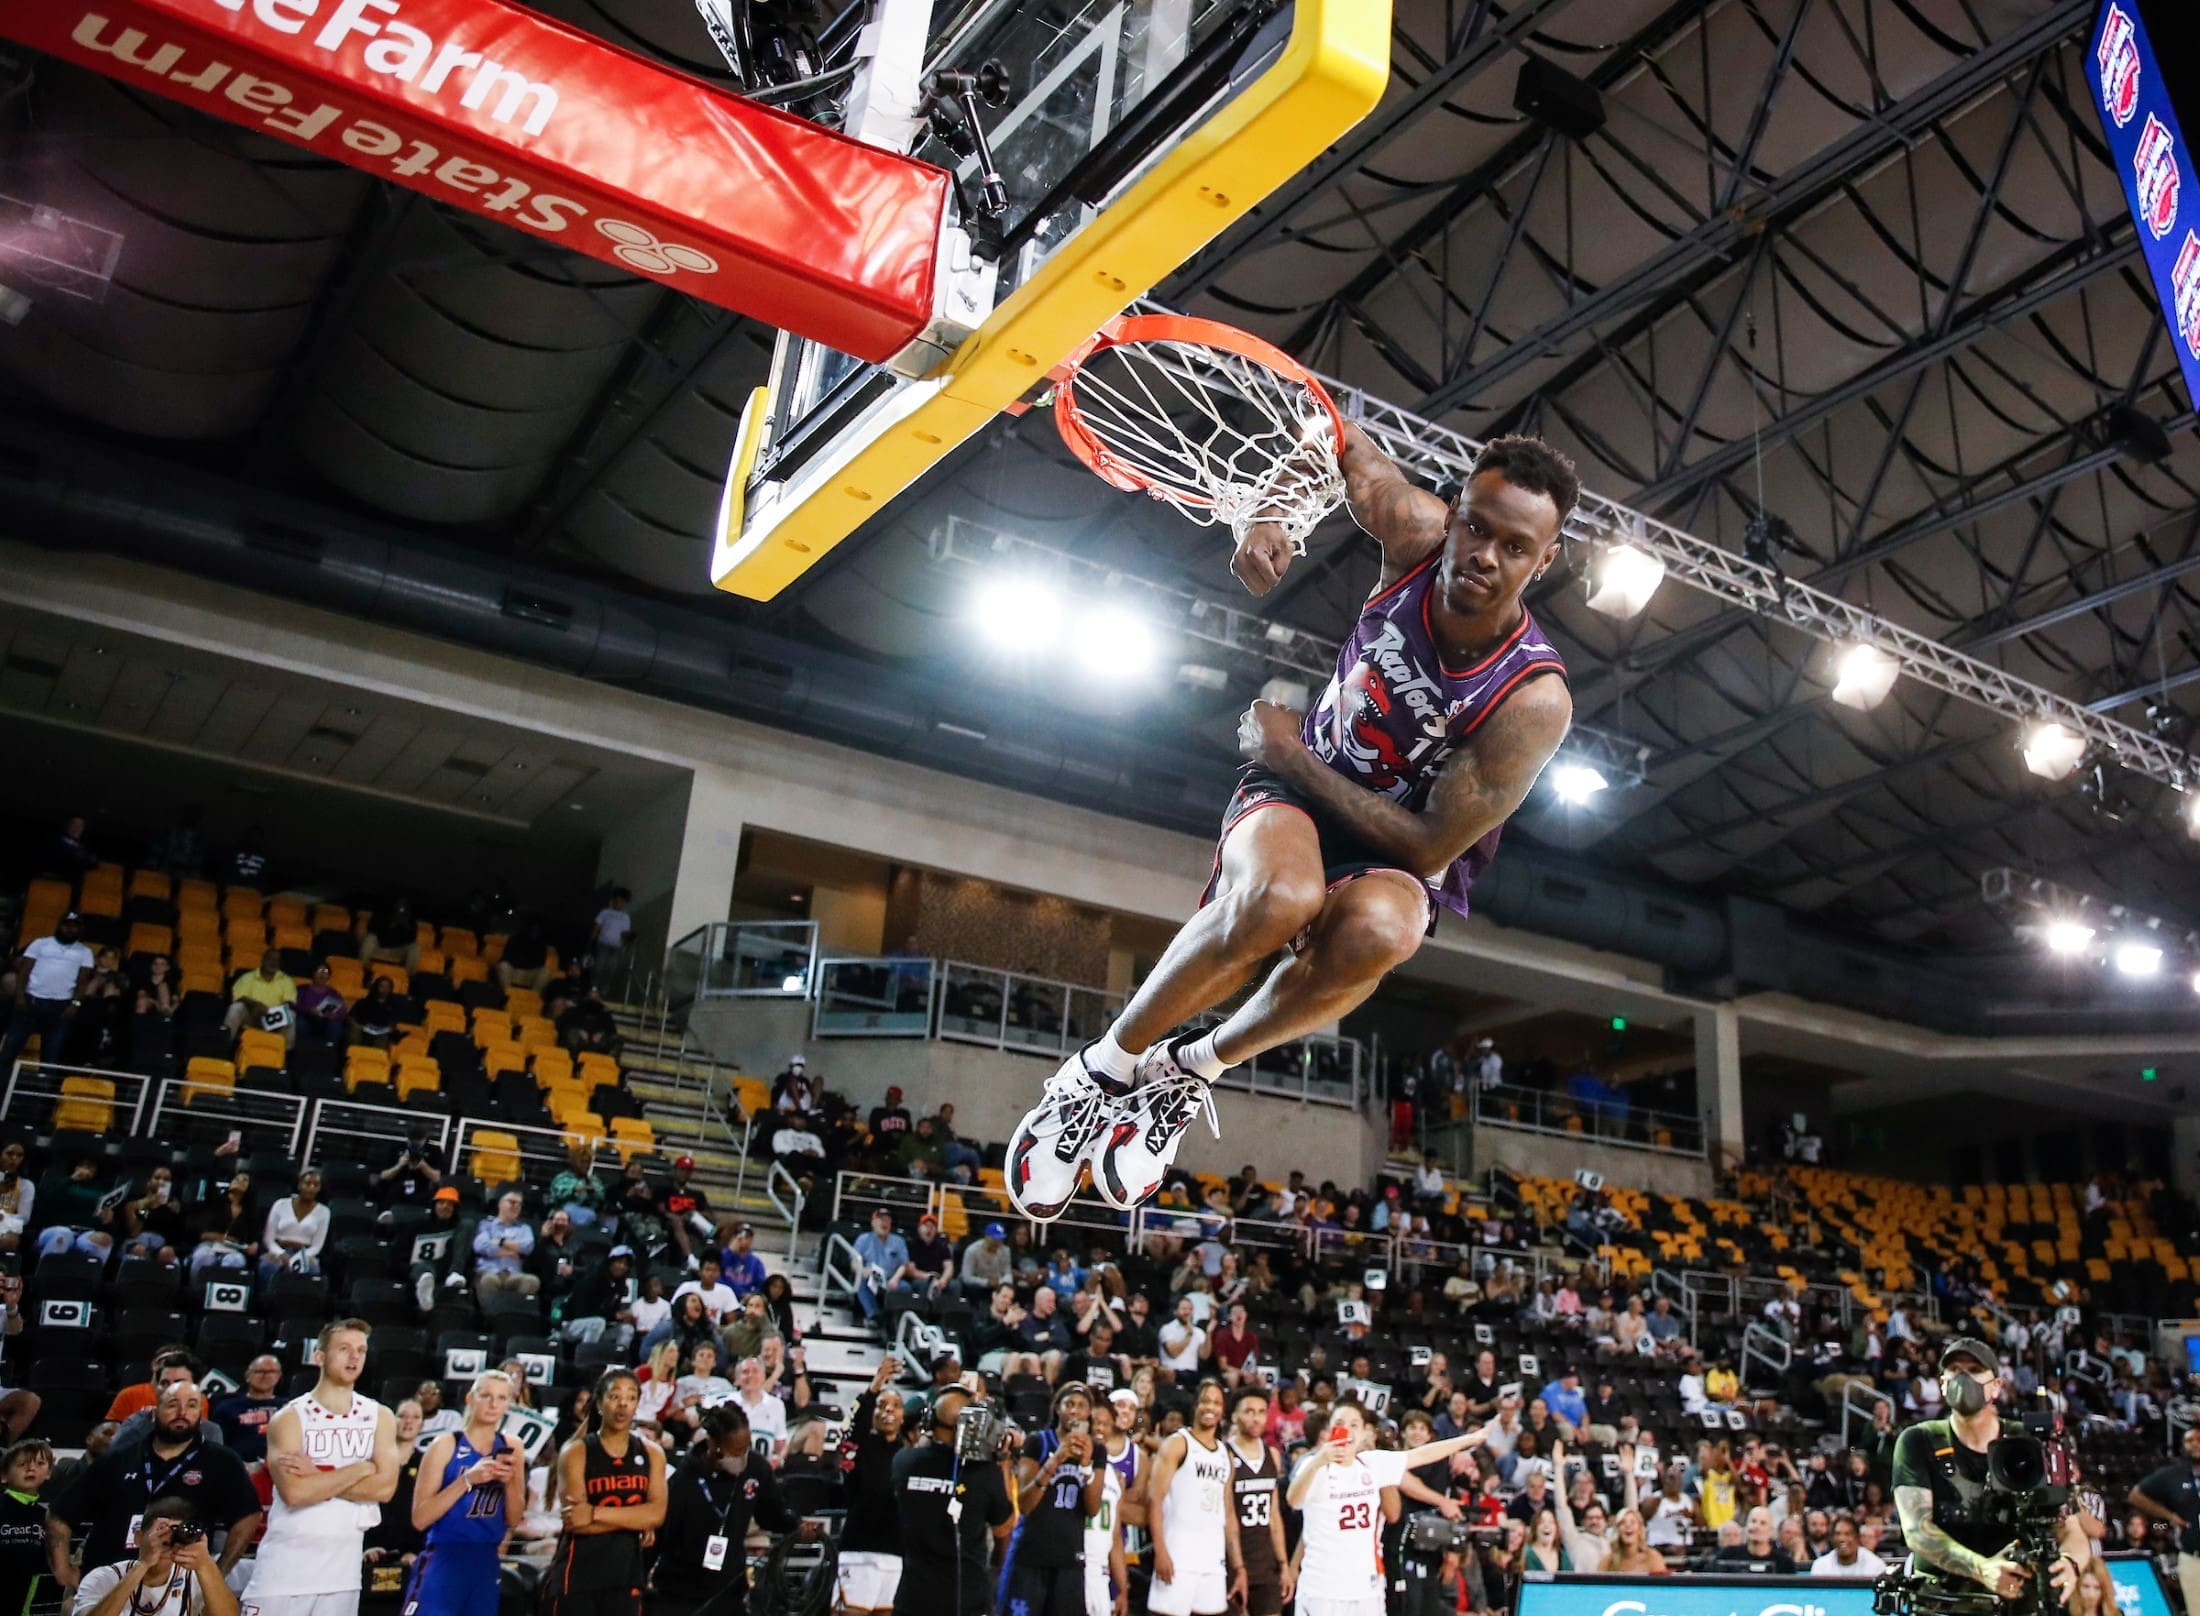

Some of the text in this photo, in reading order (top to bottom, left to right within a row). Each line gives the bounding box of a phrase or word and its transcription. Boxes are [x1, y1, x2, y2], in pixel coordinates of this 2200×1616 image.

[222, 0, 561, 136] eFarm
[265, 1011, 284, 1026] 8
[418, 1241, 437, 1260] 8
[216, 1287, 242, 1304] 8
[1344, 1305, 1354, 1318] 8
[1364, 1390, 1386, 1411] 10
[305, 1427, 374, 1458] UW
[1641, 1454, 1652, 1471] 8
[466, 1486, 501, 1518] 10
[1054, 1482, 1079, 1509] 10
[1241, 1492, 1271, 1527] 33
[1338, 1502, 1370, 1530] 23
